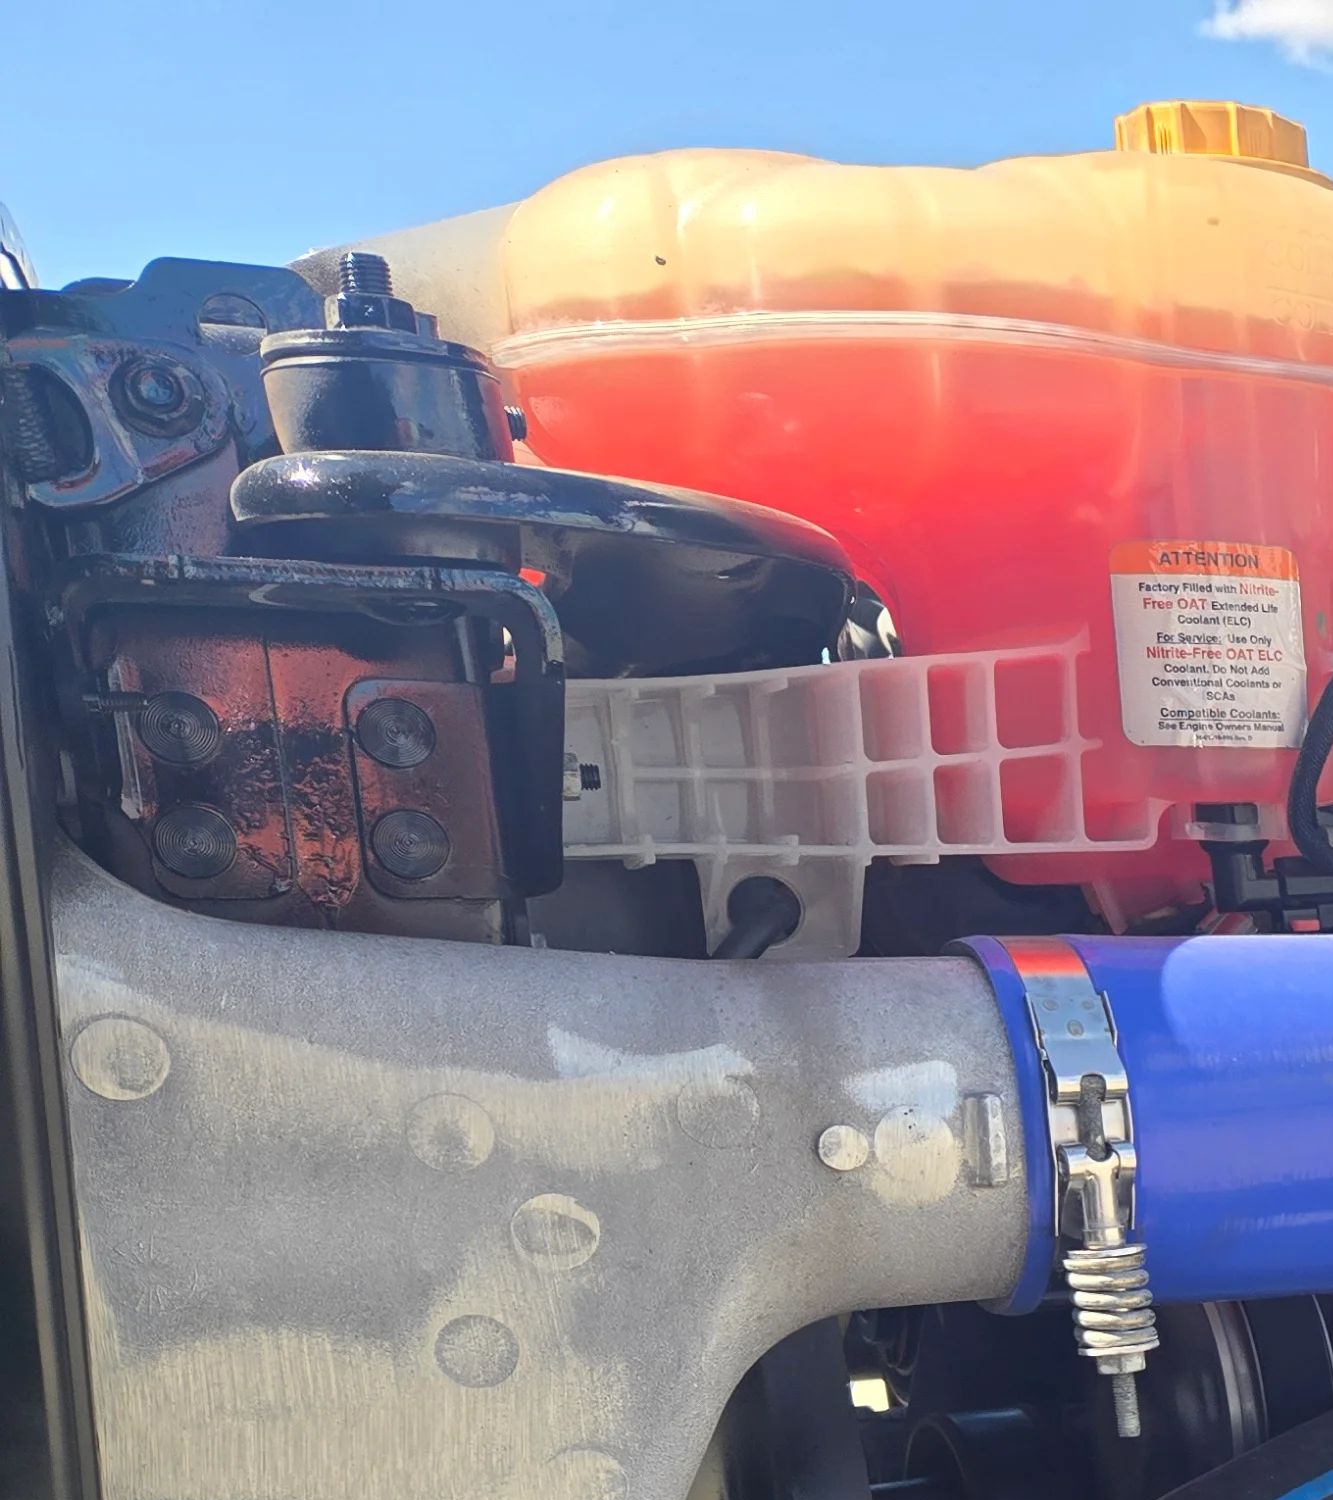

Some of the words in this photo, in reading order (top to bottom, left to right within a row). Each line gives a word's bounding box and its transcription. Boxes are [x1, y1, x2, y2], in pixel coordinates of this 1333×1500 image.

[1159, 551, 1260, 569] ATTENTION
[1138, 582, 1180, 595] Factory
[1183, 583, 1213, 594] Filled
[1214, 584, 1237, 595] with
[1239, 583, 1280, 597] Nitrite-
[1143, 597, 1173, 610] Free
[1177, 598, 1208, 611] OAT
[1211, 600, 1259, 613] Extended
[1261, 603, 1279, 614] Life
[1177, 615, 1221, 626] Coolant
[1223, 616, 1252, 629] (ELC)
[1156, 632, 1176, 644] For
[1178, 632, 1222, 645] Service:
[1227, 634, 1248, 645] Use
[1249, 635, 1273, 648] Only
[1146, 646, 1223, 660] Nitrite-Free
[1226, 648, 1254, 662] OAT
[1258, 650, 1284, 663] ELC
[1212, 665, 1228, 675] Do
[1230, 665, 1248, 675] Not
[1250, 666, 1270, 676] Add
[1152, 677, 1223, 689] Conventional
[1225, 679, 1271, 690] Coolants
[1272, 680, 1283, 690] or
[1206, 691, 1236, 702] SCAs
[1160, 707, 1228, 721] Compatible
[1230, 708, 1281, 721] Coolants:
[1158, 721, 1177, 731] See
[1179, 721, 1214, 733] Engine
[1215, 722, 1252, 732] Owners
[1254, 723, 1285, 733] Manual
